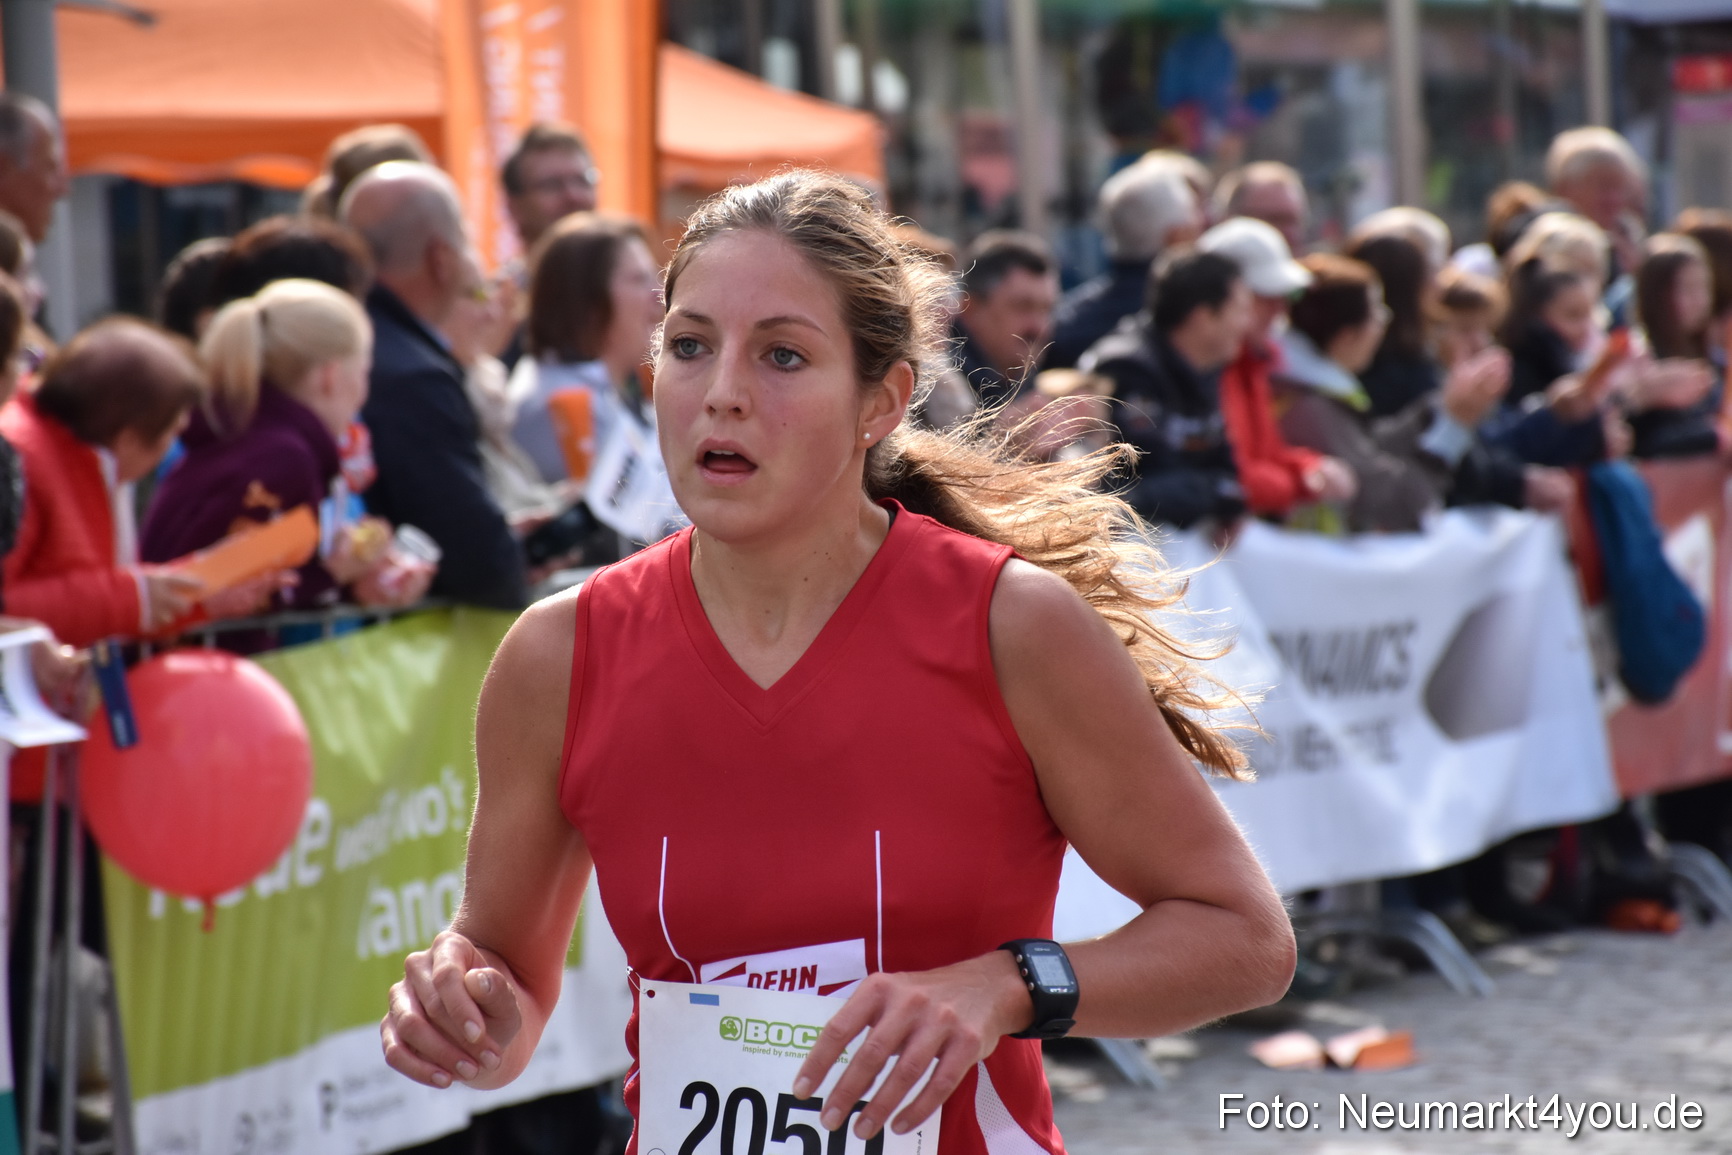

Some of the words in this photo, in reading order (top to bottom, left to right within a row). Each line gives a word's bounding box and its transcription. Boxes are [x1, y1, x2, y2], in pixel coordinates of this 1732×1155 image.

[747, 964, 818, 992] DEHN
[744, 1018, 848, 1054] BOC
[742, 1044, 772, 1056] inspired
[772, 1047, 783, 1058] by
[784, 1051, 808, 1059] smart
